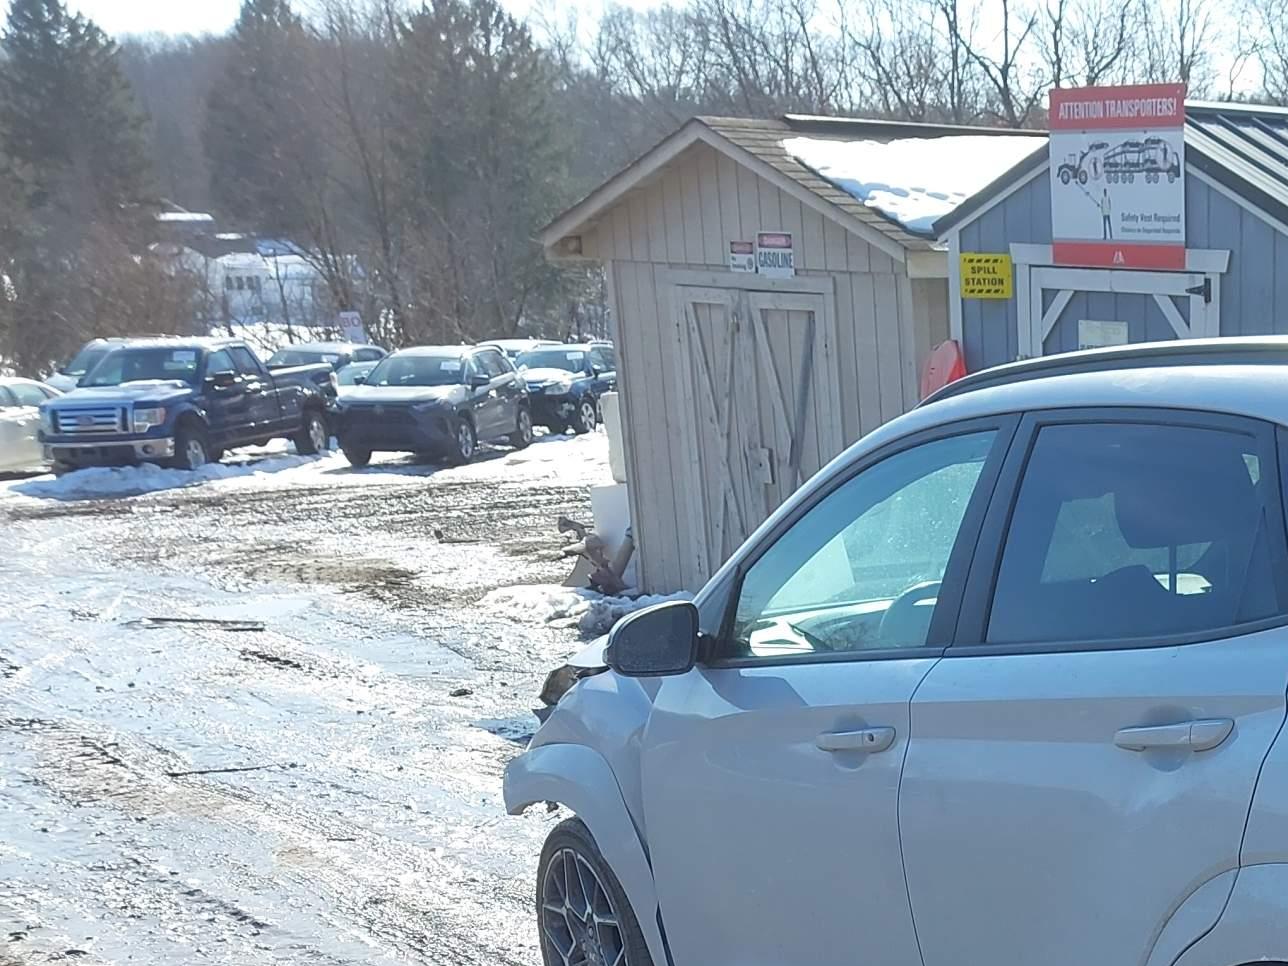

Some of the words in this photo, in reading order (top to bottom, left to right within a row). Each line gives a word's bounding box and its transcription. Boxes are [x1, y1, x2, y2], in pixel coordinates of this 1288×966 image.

[1058, 100, 1103, 120] ATTENTION
[1105, 97, 1177, 118] TRANSPORTERS!
[759, 251, 793, 268] GASOLINE
[970, 266, 997, 275] SPILL
[964, 277, 1004, 287] STATION
